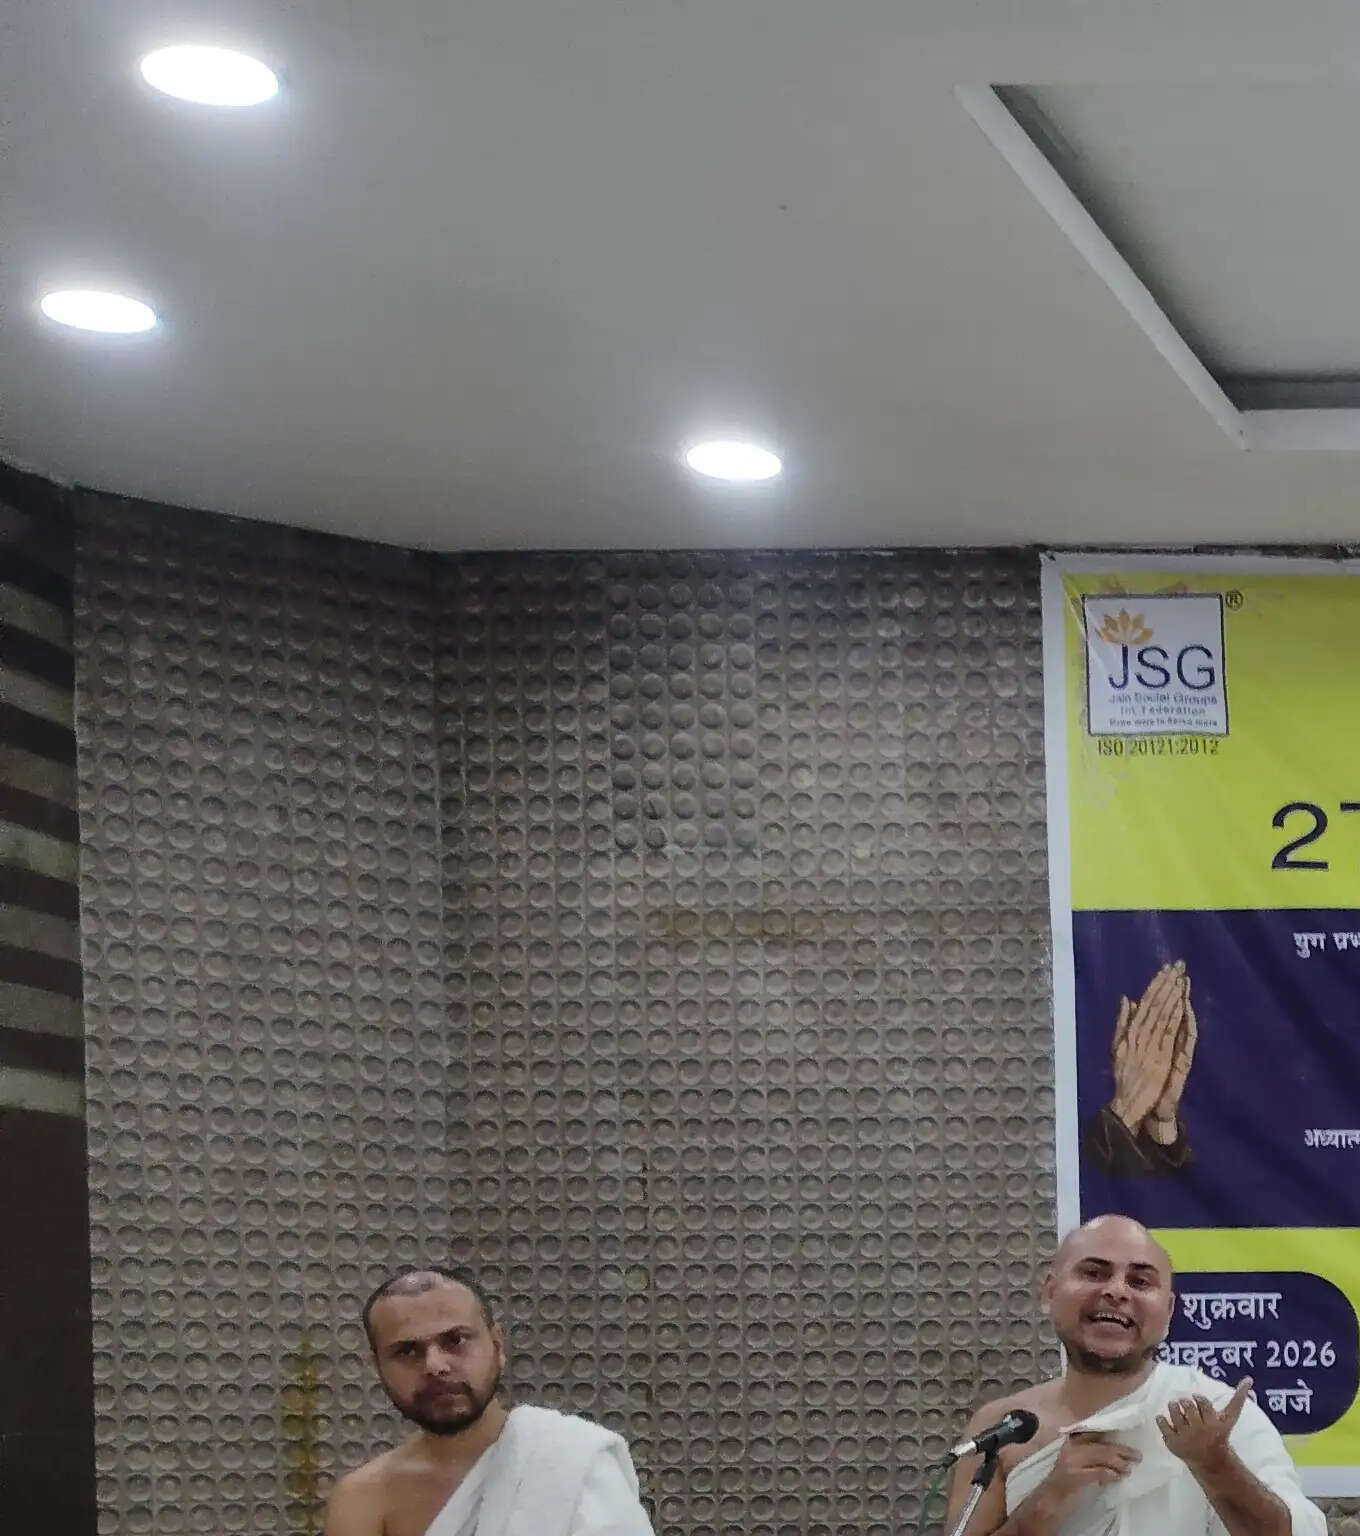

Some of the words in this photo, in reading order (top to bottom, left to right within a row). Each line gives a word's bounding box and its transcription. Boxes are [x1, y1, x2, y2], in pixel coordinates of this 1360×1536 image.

[1107, 644, 1216, 691] JSG
[1097, 738, 1124, 756] ISO
[1293, 932, 1326, 959] युग
[1181, 1291, 1283, 1331] शुक्रवार
[1156, 1339, 1258, 1379] अक्टूबर
[1265, 1338, 1337, 1369] 2026
[1265, 1378, 1314, 1416] बजे
